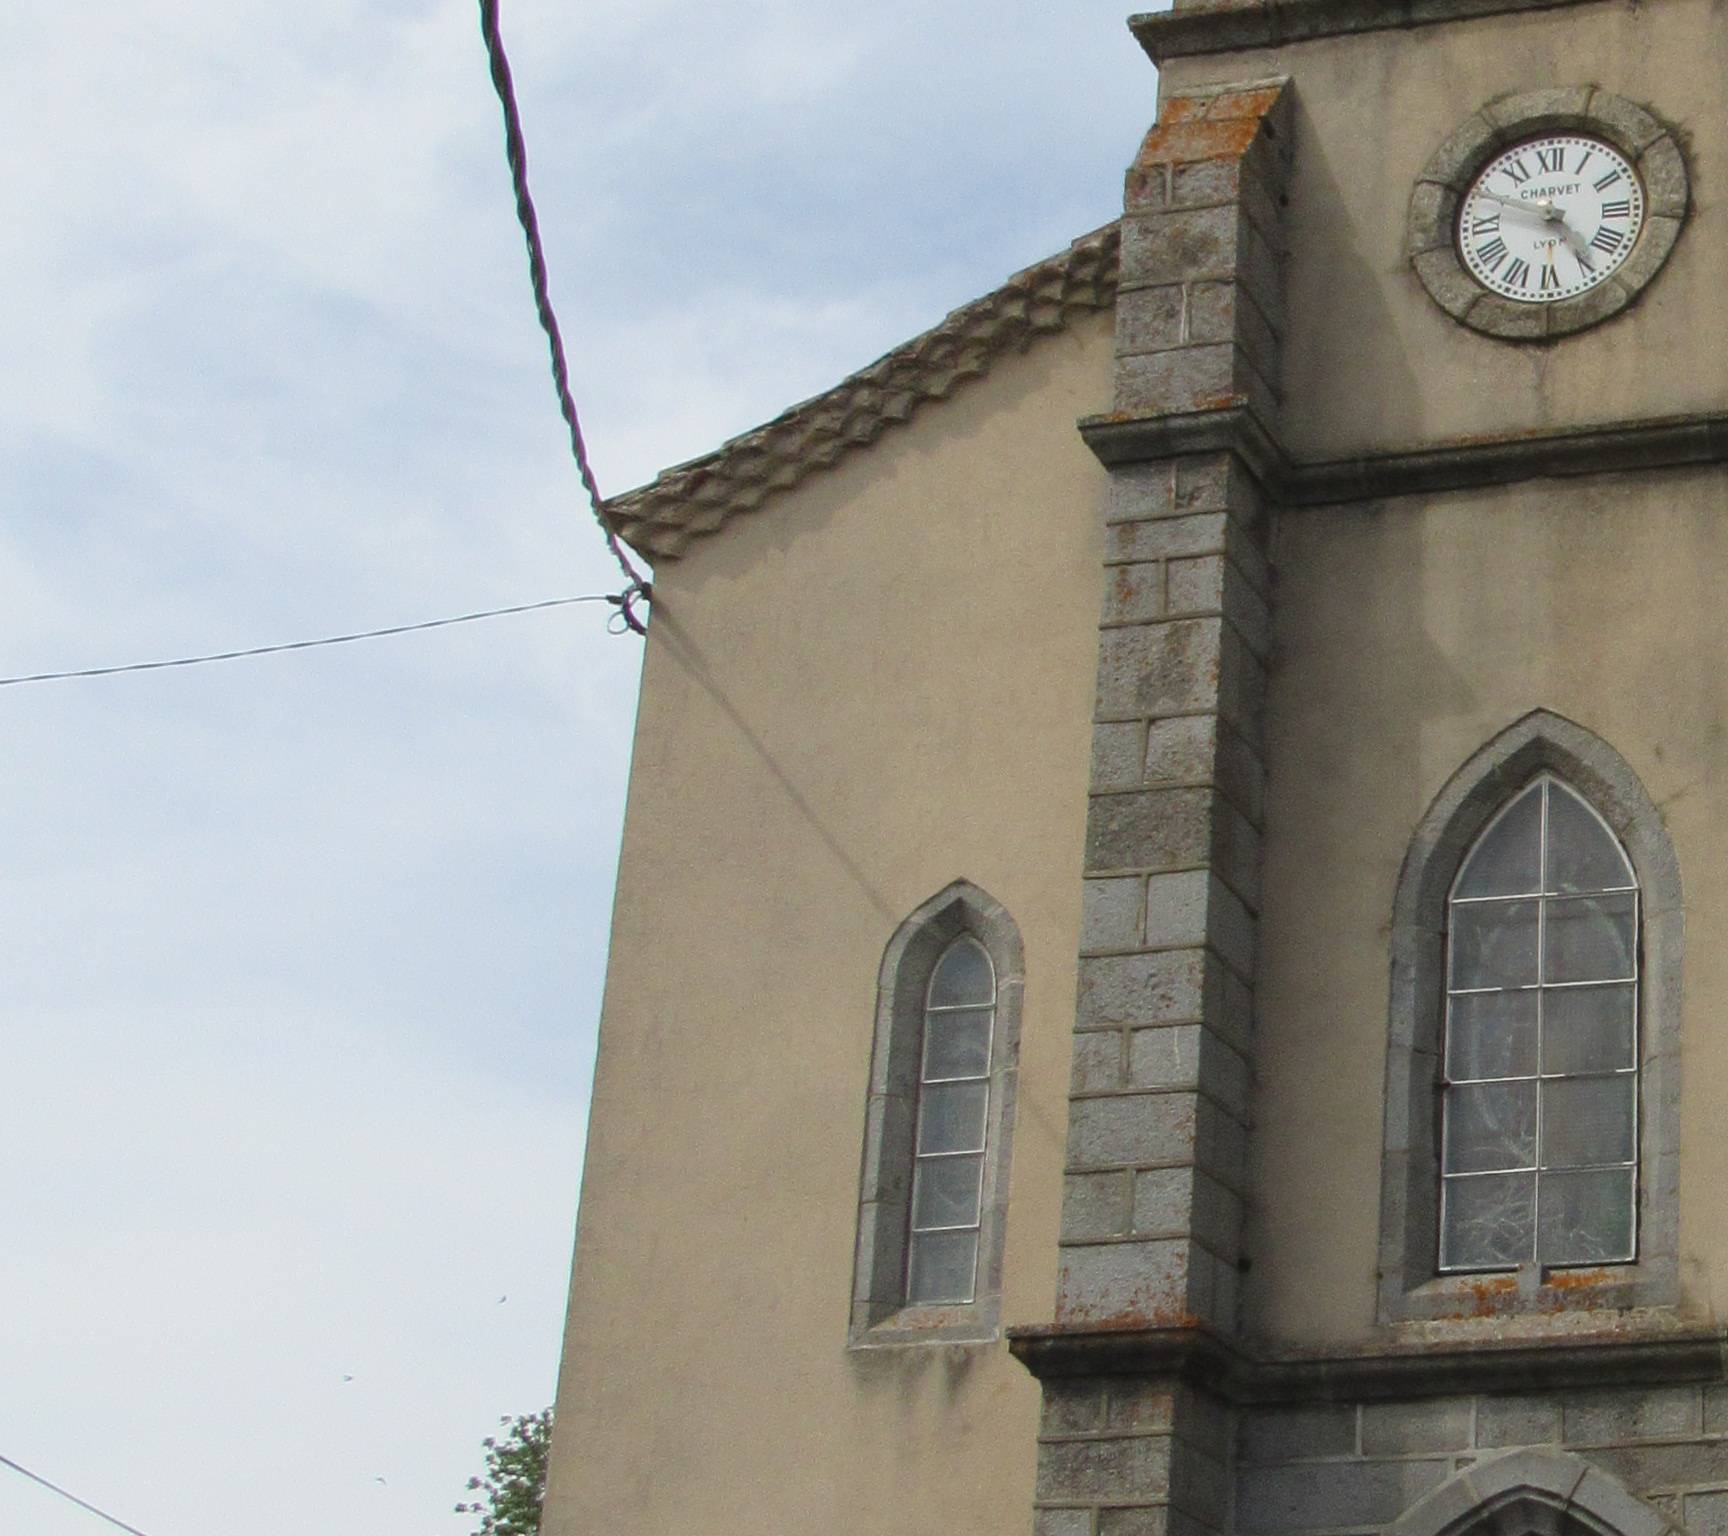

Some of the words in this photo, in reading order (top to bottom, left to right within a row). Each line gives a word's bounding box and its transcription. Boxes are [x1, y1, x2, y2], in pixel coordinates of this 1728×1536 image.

[1536, 147, 1565, 175] XII
[1574, 151, 1593, 175] I
[1502, 159, 1531, 188] XI
[1593, 169, 1622, 193] II
[1520, 183, 1582, 200] CHARVET
[1601, 199, 1631, 219] III
[1472, 213, 1501, 236] IX
[1502, 257, 1531, 289] VII
[1540, 264, 1560, 290] VI
